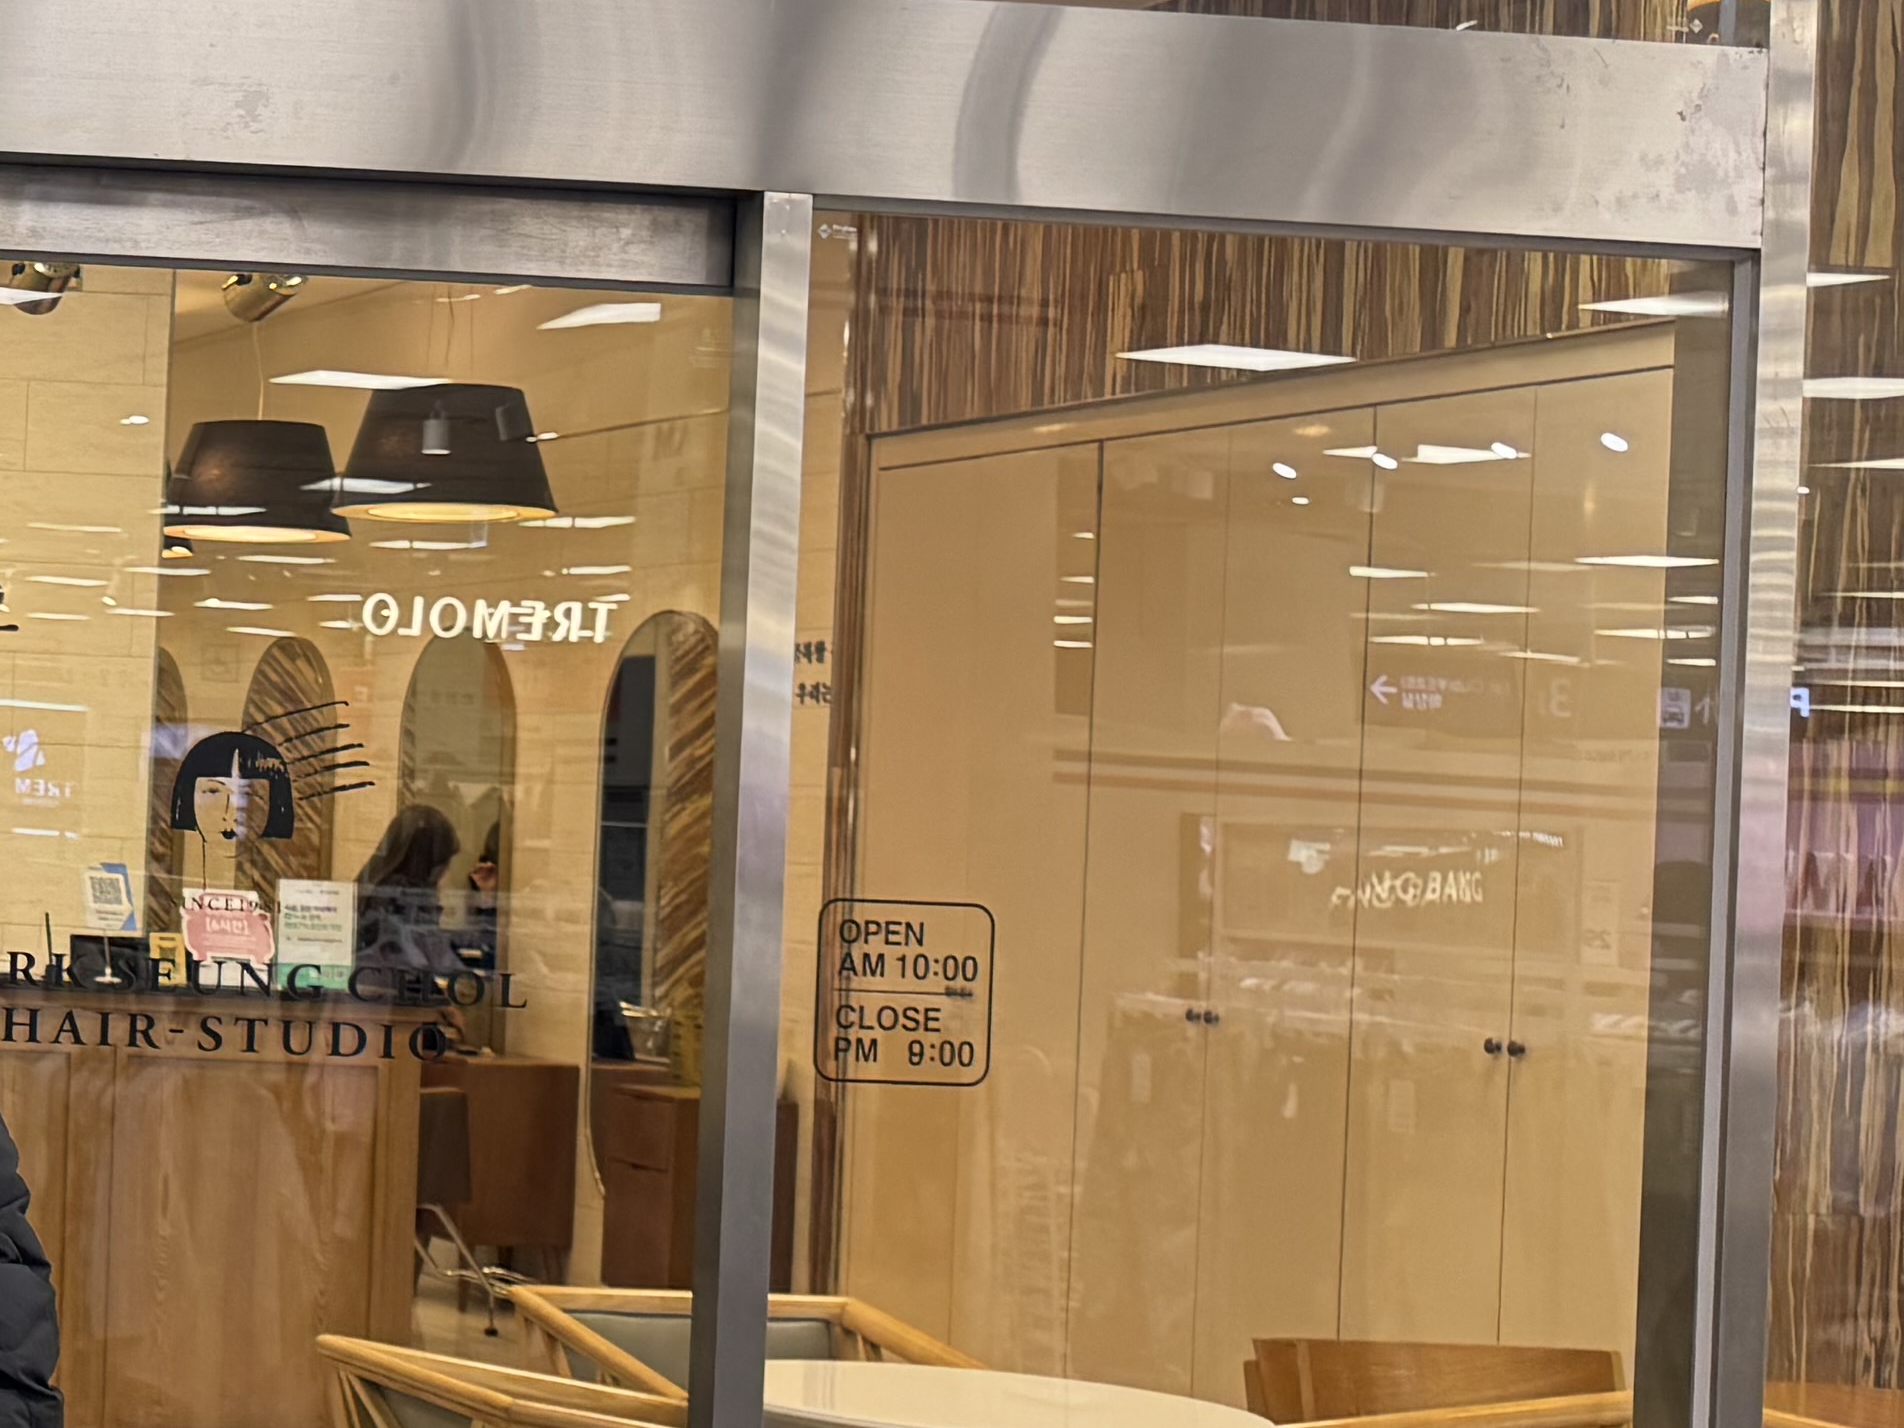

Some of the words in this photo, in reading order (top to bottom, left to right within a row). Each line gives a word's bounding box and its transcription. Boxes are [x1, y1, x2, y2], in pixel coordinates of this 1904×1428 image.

[839, 919, 925, 948] OPEN
[113, 955, 325, 1004] SEUNG
[838, 951, 886, 978] AM
[895, 953, 979, 983] 10:00
[1, 1006, 449, 1062] HAIR-STUDIO
[835, 1004, 942, 1033] CLOSE
[833, 1036, 878, 1063] PM
[907, 1040, 975, 1068] 9:00
